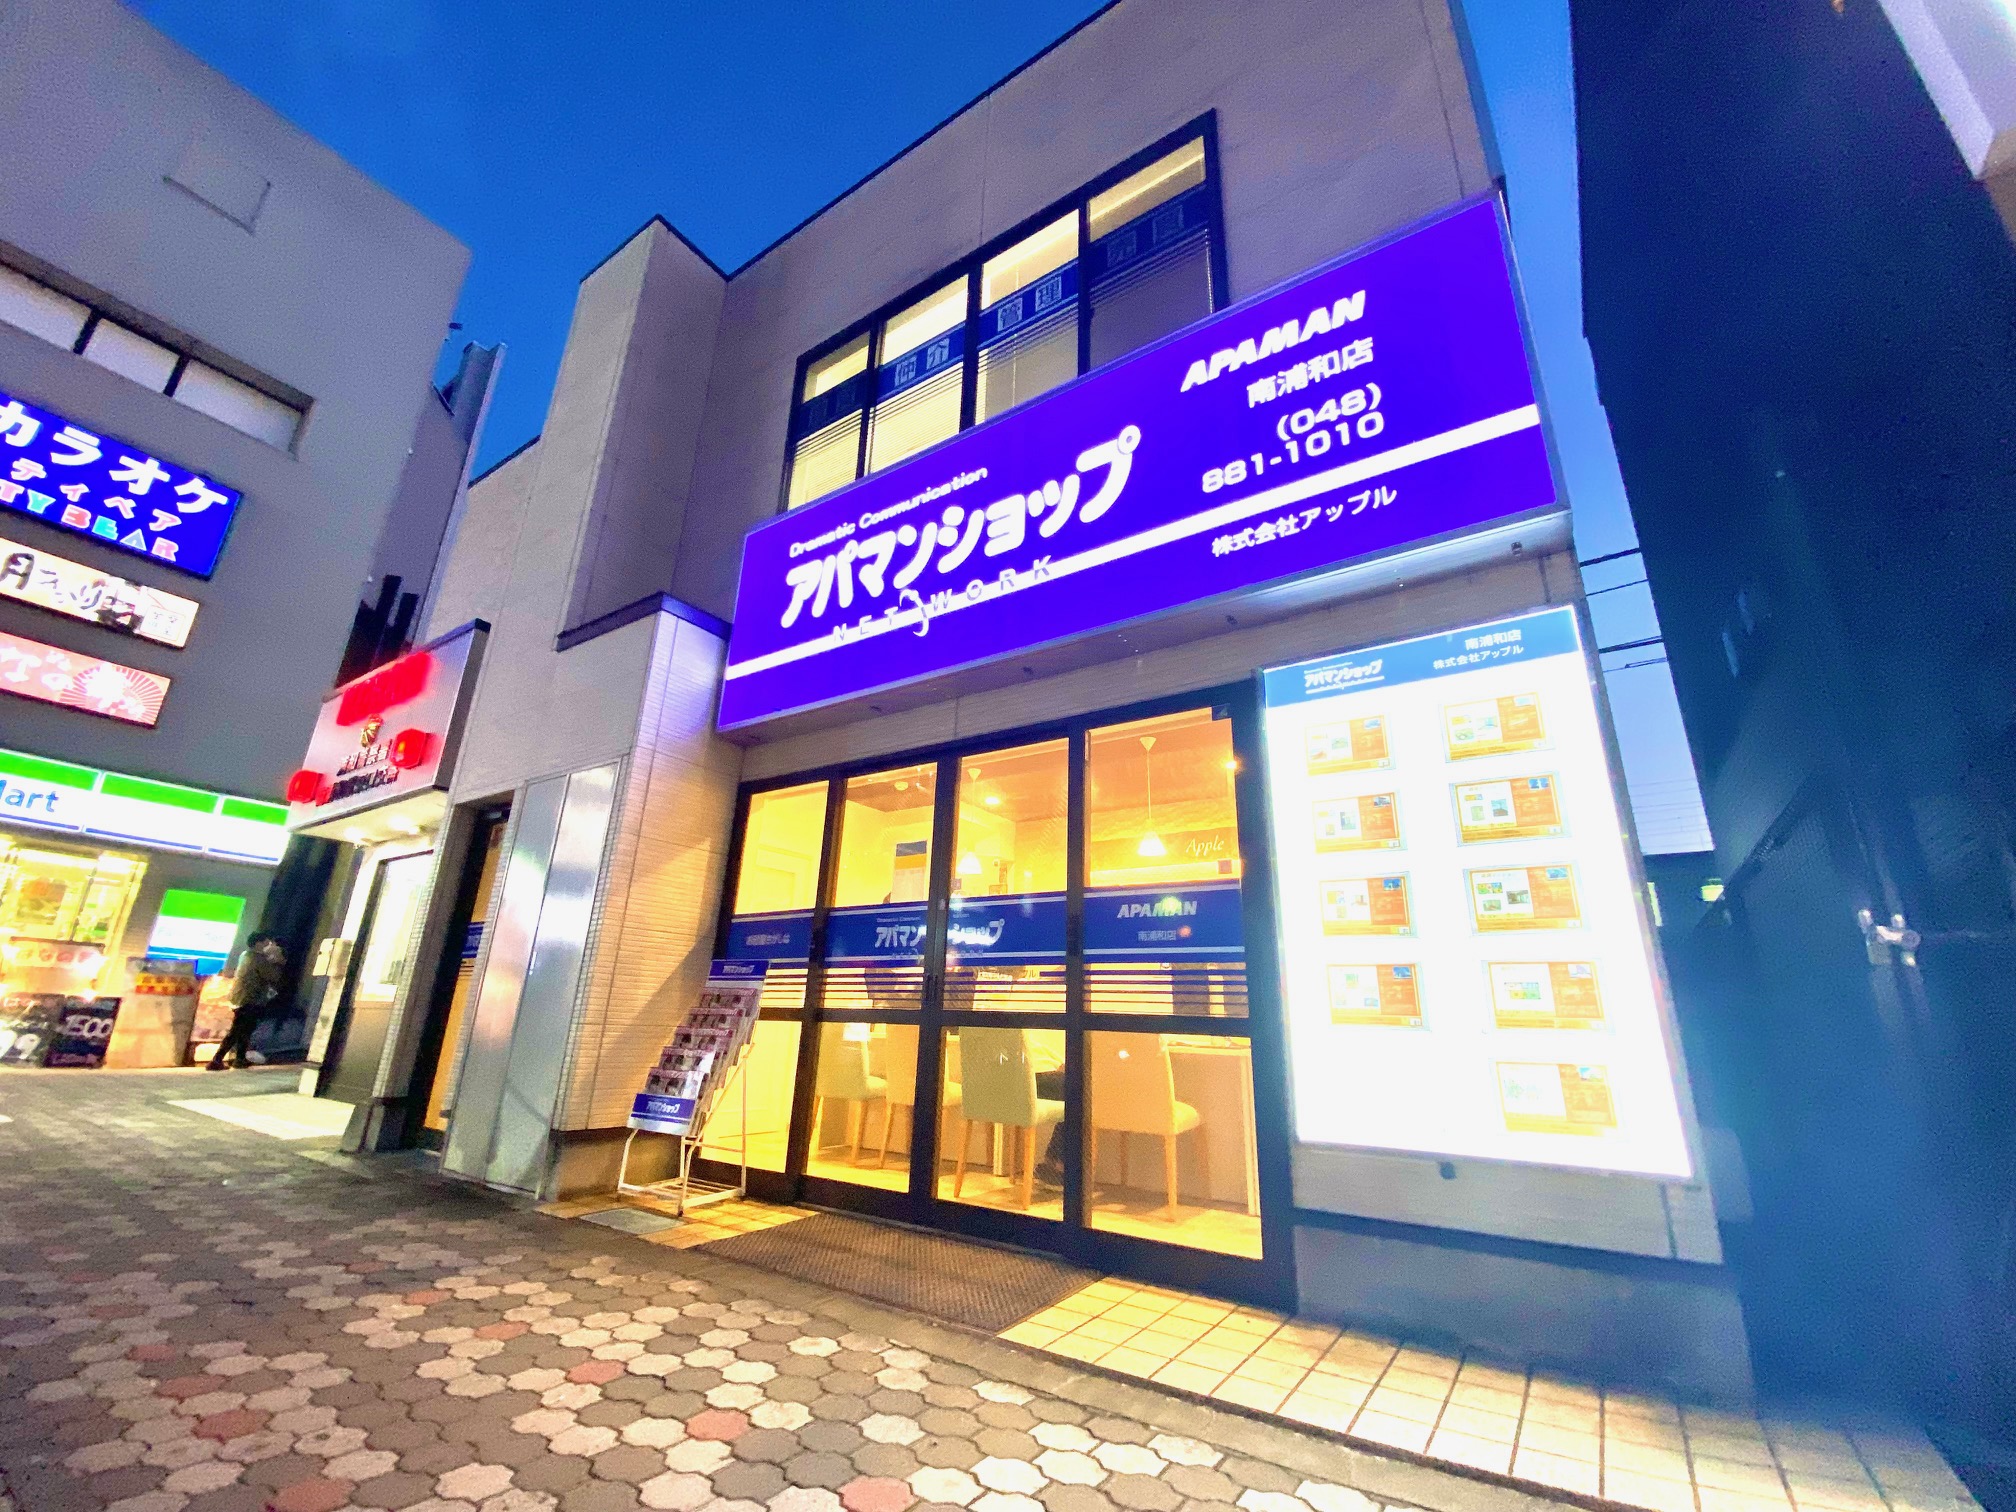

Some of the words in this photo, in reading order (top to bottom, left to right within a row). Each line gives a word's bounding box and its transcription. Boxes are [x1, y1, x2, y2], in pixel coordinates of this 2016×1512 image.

[1180, 290, 1366, 392] APAMAN
[1247, 337, 1374, 408] 南浦和店
[1276, 382, 1382, 441] (048)
[0, 401, 228, 513] カラオケ
[1201, 411, 1384, 493] 881-1010
[61, 504, 179, 562] BEAR
[780, 424, 1141, 628] アパマンショップ
[789, 522, 856, 558] Dramatic
[859, 467, 988, 529] Communication
[1211, 485, 1397, 557] 株式会社アップル
[1433, 645, 1524, 670] 株式会社アップル
[1465, 629, 1521, 650] 南浦和店
[1185, 835, 1224, 857] Apple
[1117, 901, 1197, 918] APAMAN
